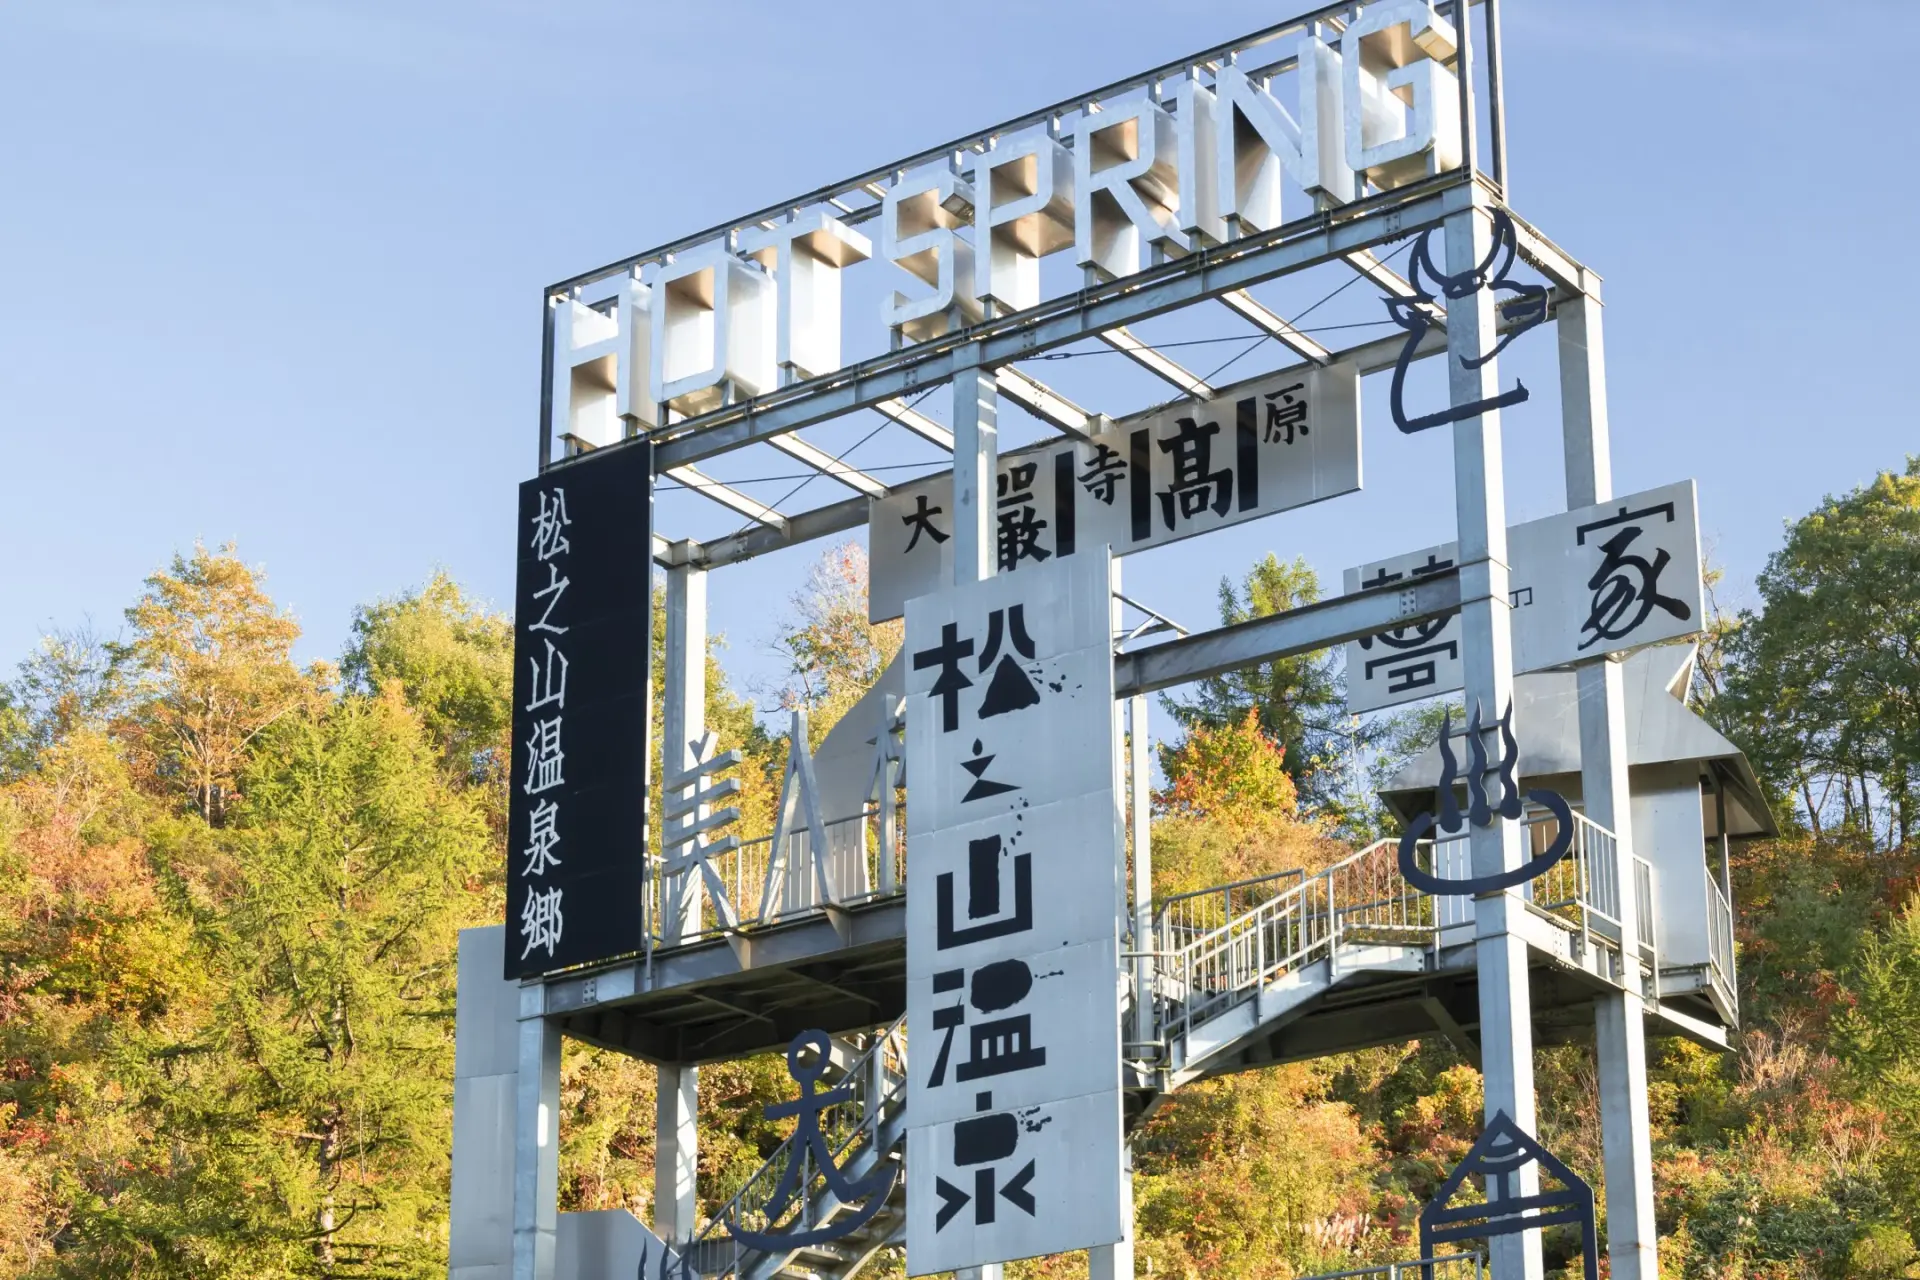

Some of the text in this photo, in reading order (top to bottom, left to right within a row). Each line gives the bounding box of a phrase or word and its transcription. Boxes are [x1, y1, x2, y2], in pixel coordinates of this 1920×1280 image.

[555, 0, 1466, 448] HOT SPRING
[520, 487, 572, 960] 松之山温泉郷
[913, 603, 1046, 1233] 松之山温泉
